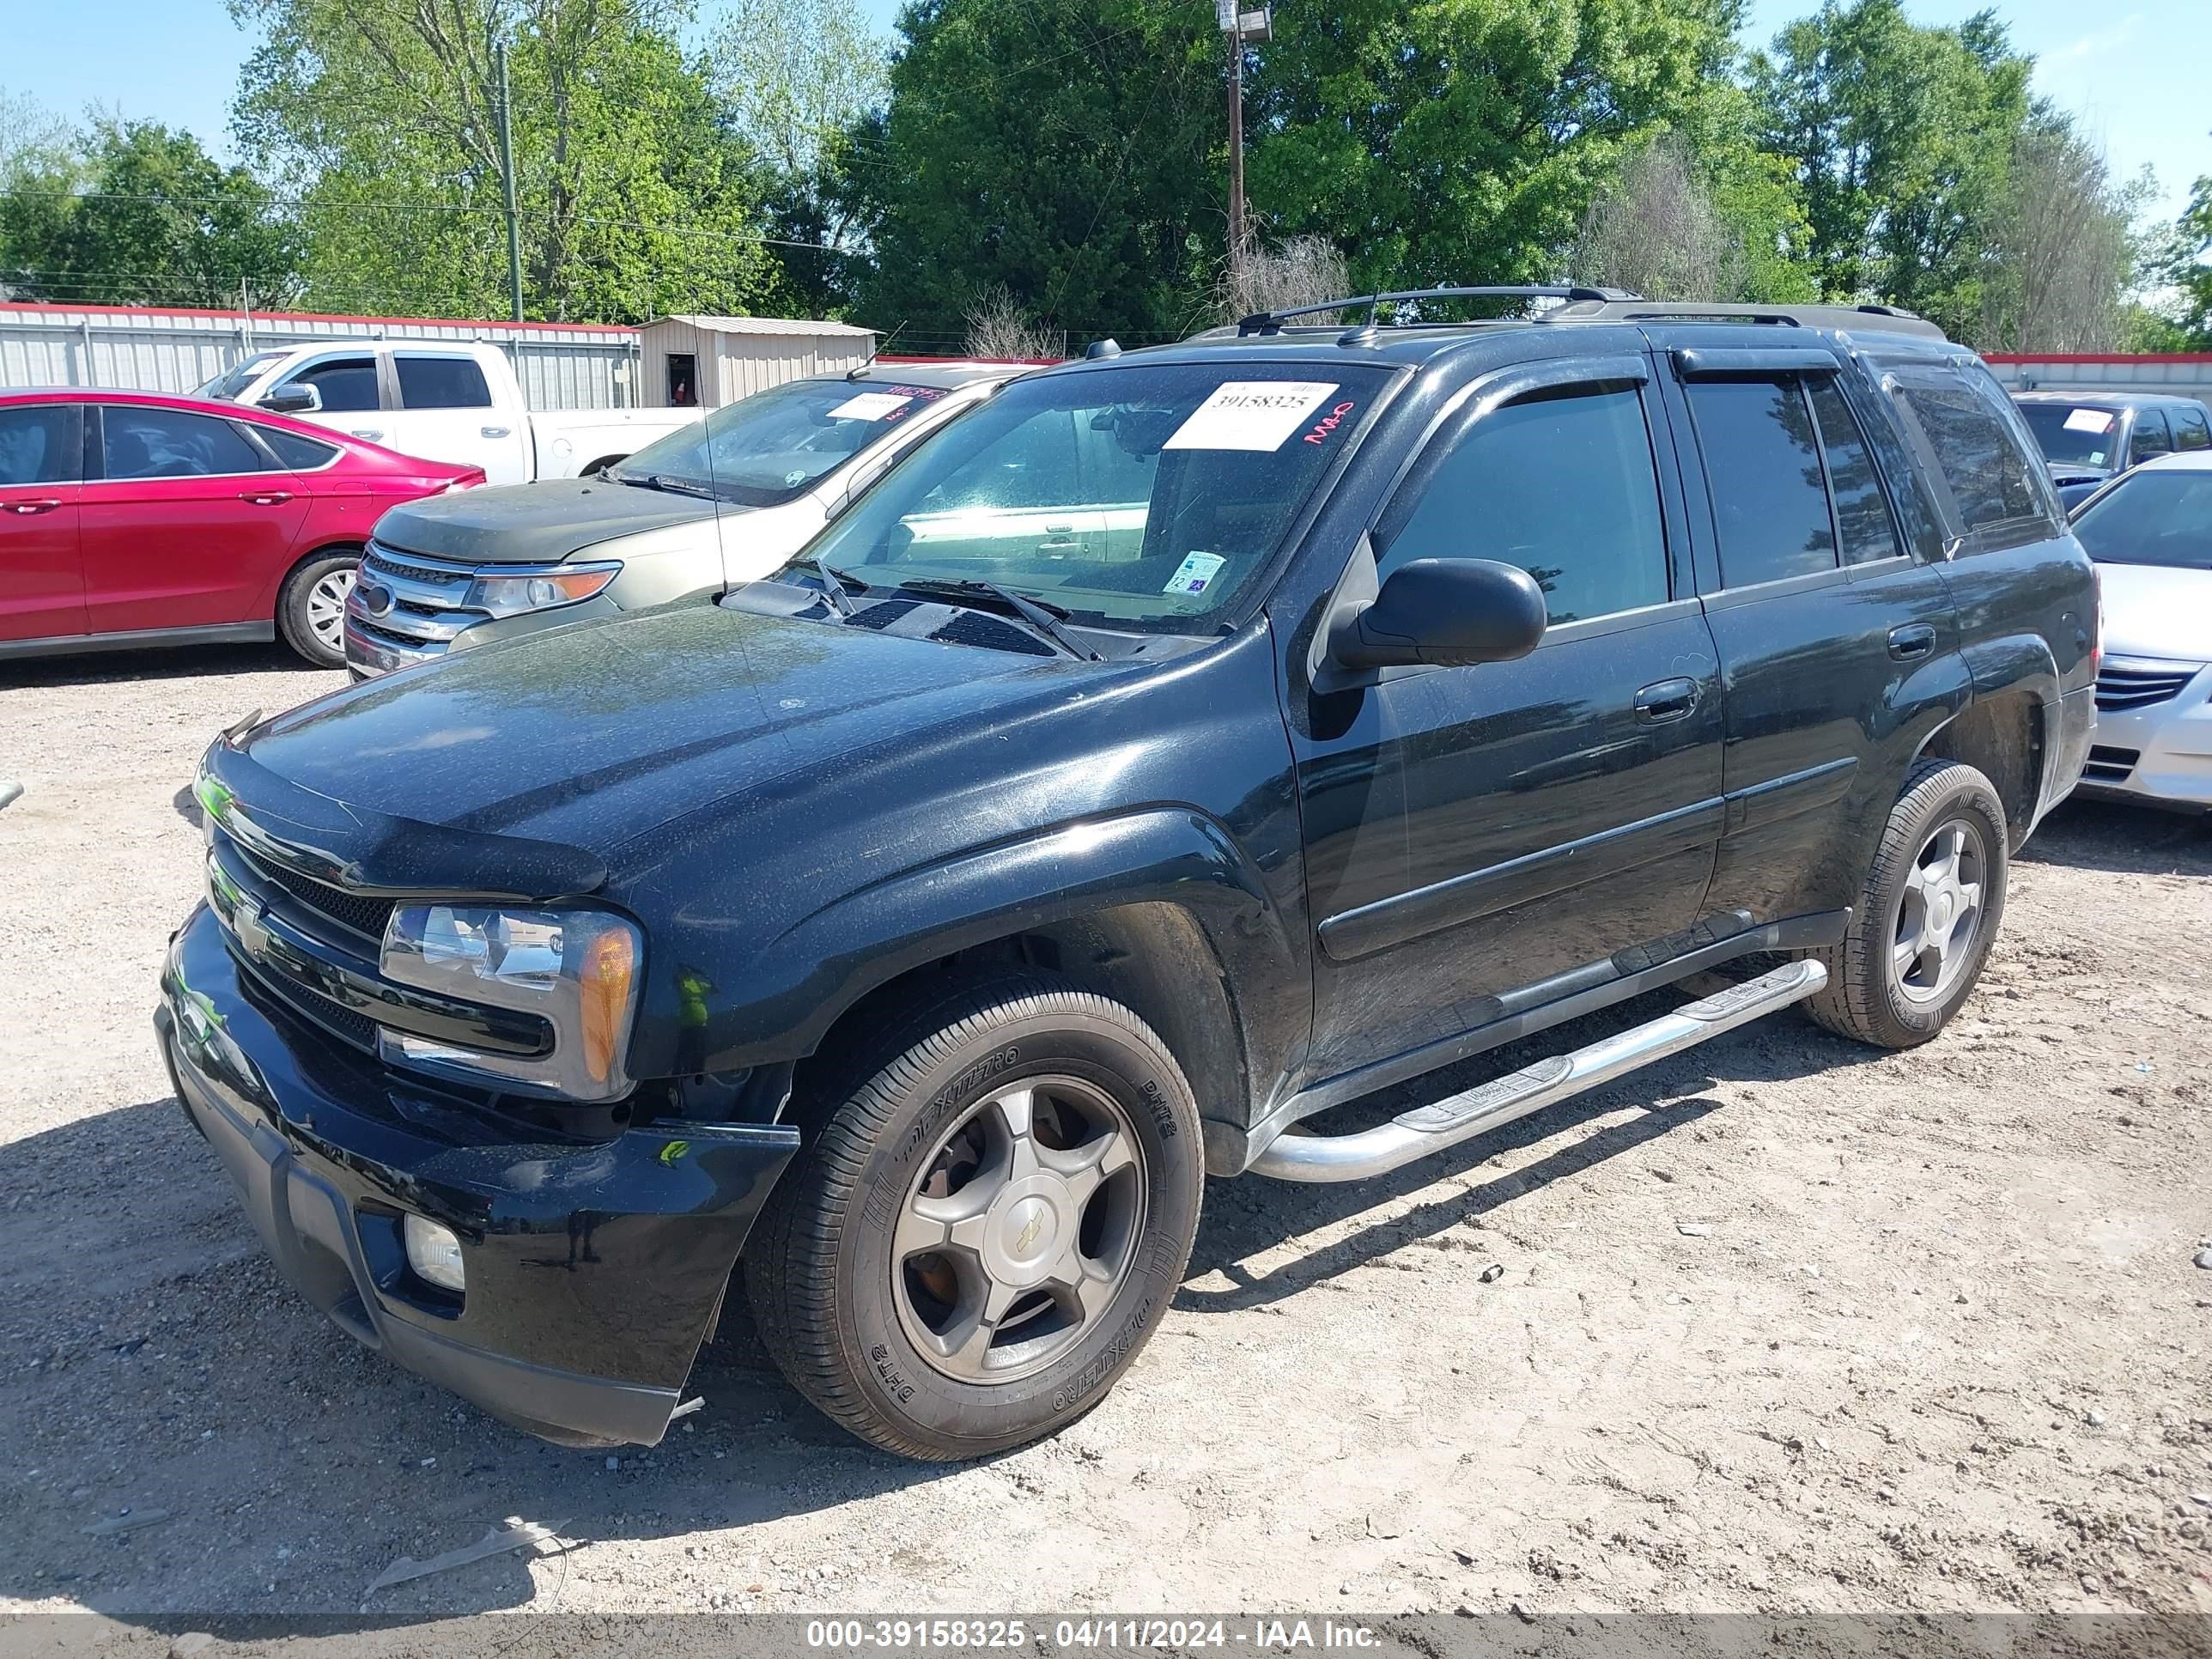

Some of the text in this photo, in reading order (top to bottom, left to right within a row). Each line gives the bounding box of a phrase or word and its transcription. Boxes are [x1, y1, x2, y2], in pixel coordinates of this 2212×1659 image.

[1212, 395, 1310, 409] 39158325
[1171, 576, 1185, 587] 12
[1188, 580, 1205, 591] 23
[1141, 1079, 1177, 1139] DHT2
[872, 1343, 916, 1404] DHT2
